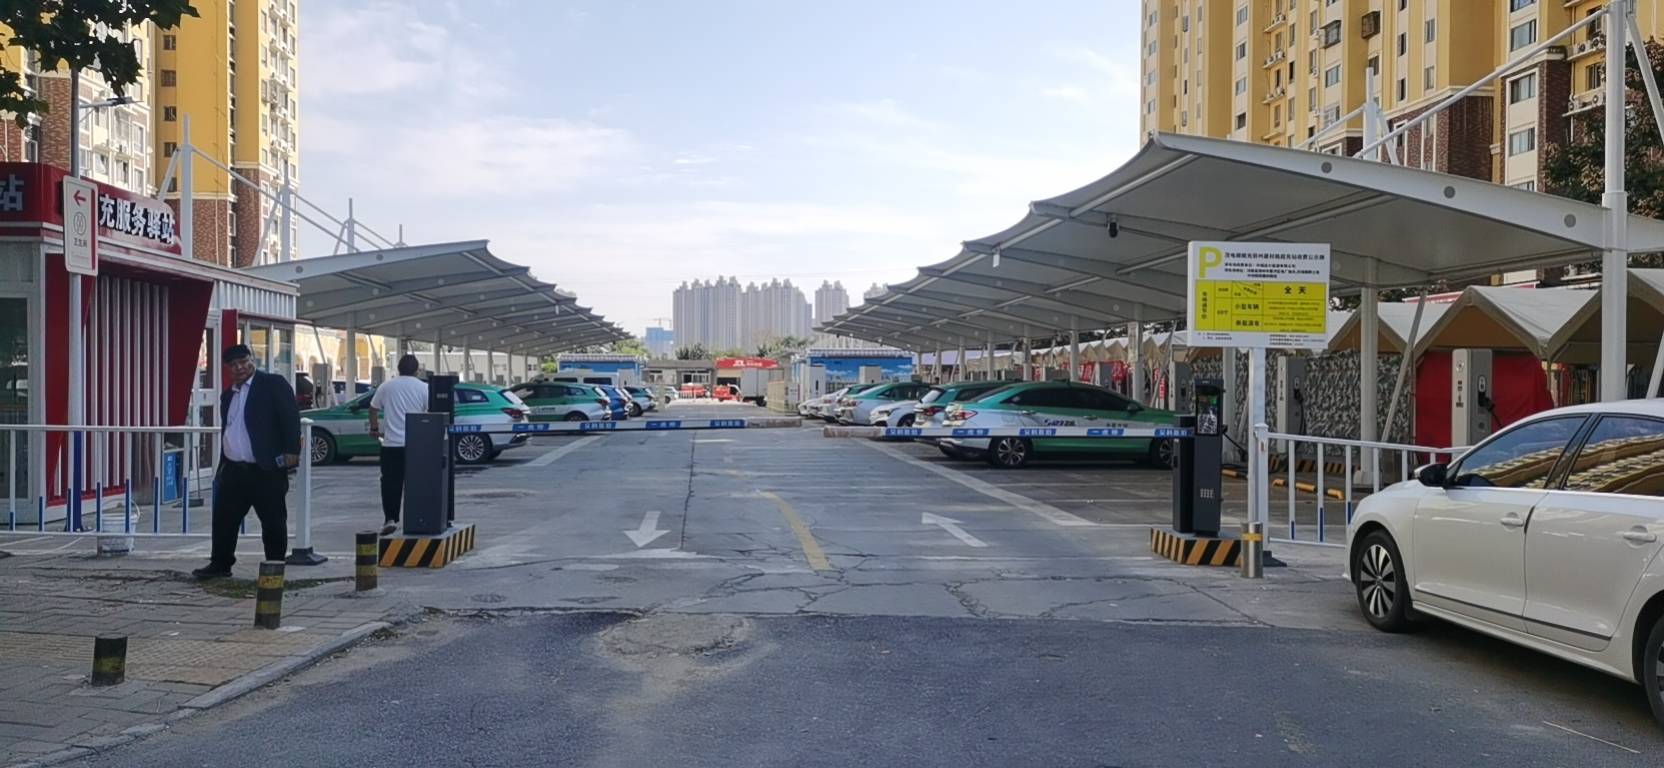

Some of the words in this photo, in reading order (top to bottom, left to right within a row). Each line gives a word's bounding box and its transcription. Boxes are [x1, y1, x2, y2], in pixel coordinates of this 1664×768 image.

[0, 173, 25, 212] 站
[98, 193, 176, 245] 充服务驿站
[1198, 246, 1222, 279] P
